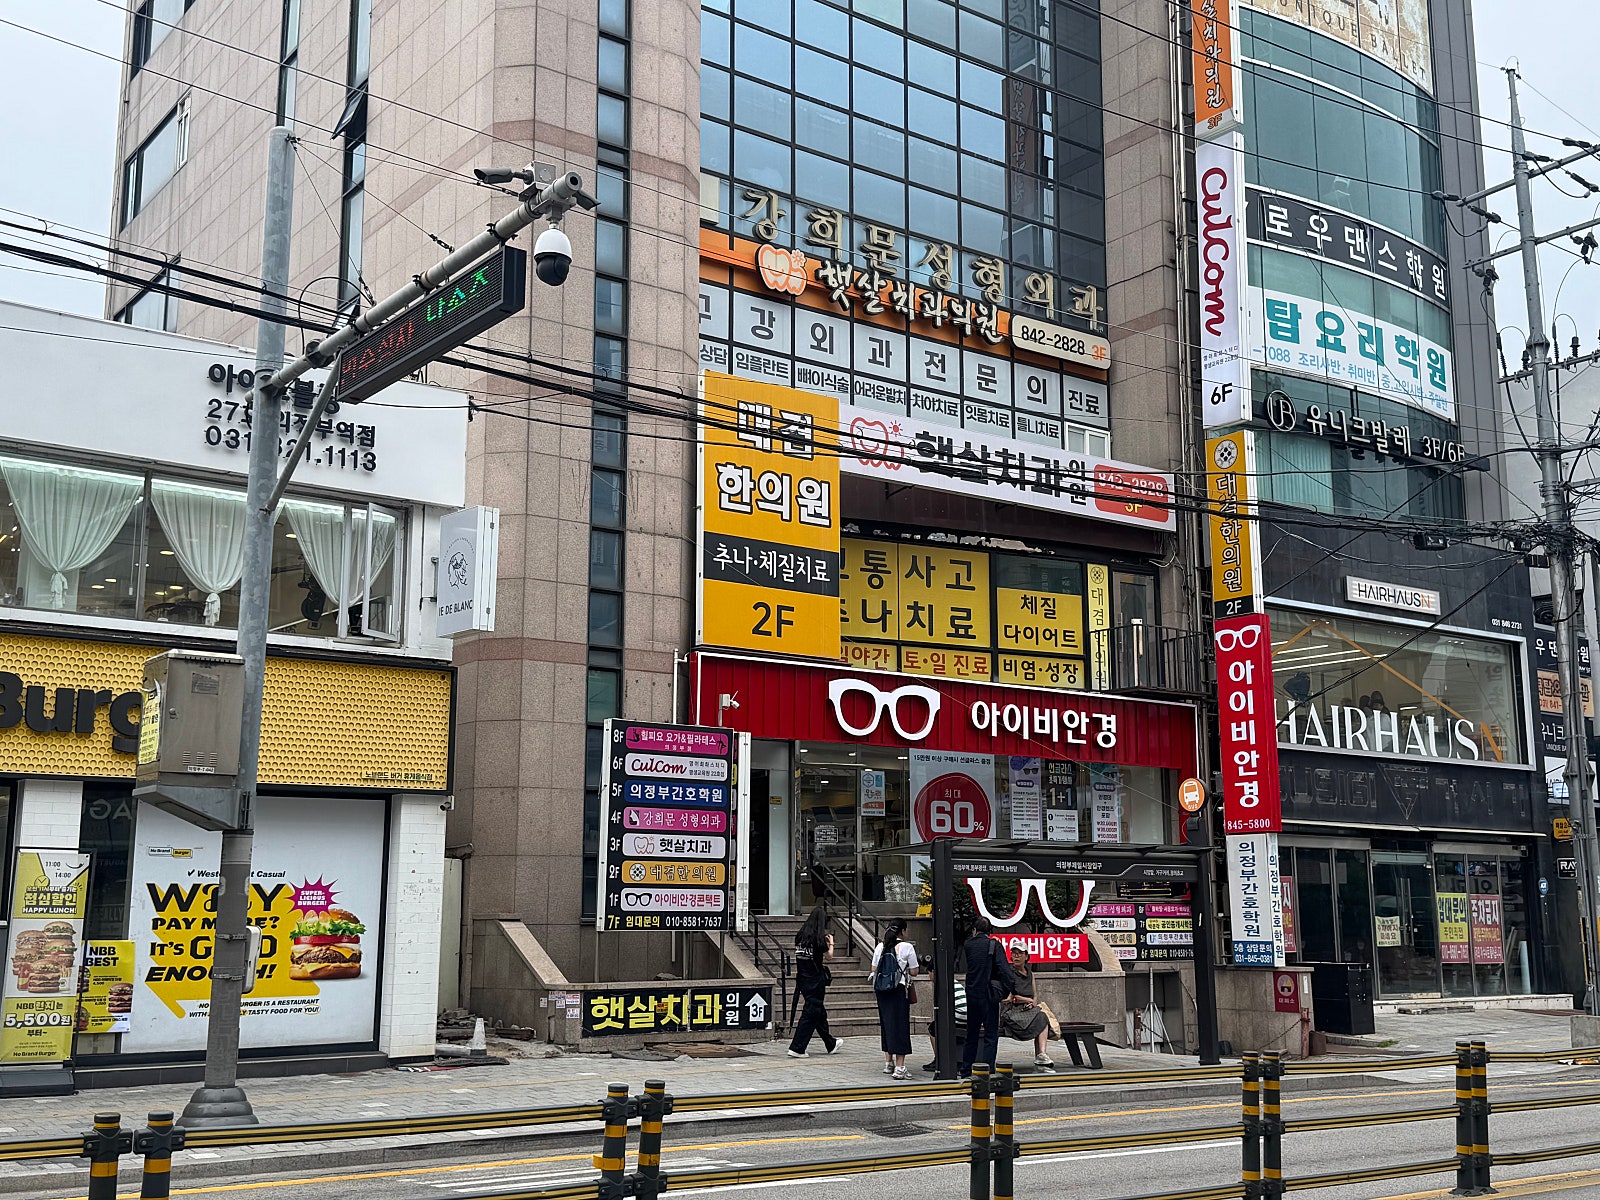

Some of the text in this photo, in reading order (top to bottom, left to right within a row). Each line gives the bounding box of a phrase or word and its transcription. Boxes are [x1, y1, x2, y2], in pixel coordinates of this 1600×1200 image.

[1207, 114, 1222, 129] 3F
[1201, 167, 1233, 337] CulCom
[816, 260, 1005, 345] 햇살치과의원
[1021, 325, 1107, 361] 842-2828 3F
[1265, 298, 1447, 392] 탑요리학원
[736, 352, 789, 379] 임플란트
[797, 368, 850, 395] 뼈이식술
[855, 380, 906, 406] 어려운발치
[912, 393, 958, 418] 치아치료
[965, 404, 1010, 428] 잇몸치료
[1017, 416, 1059, 439] 틀니치료
[1068, 389, 1100, 415] 진료
[1211, 383, 1232, 405] 6F
[1307, 405, 1412, 457] 유니크발레
[715, 462, 832, 530] 한의원
[713, 543, 831, 584] 추나·체질치료
[445, 604, 453, 615] DE
[454, 599, 473, 614] BLANC
[1021, 594, 1057, 619] 체질
[1226, 600, 1242, 615] 2F
[752, 602, 795, 638] 2F
[1004, 625, 1079, 649] 다이어트
[953, 654, 989, 676] 진료
[1003, 659, 1079, 684] 비염·성장
[0, 671, 142, 753] Burg
[970, 698, 1118, 749] 아이비안경
[613, 729, 624, 743] 8F
[1229, 660, 1260, 808] 아이비안경
[612, 758, 687, 775] 6F CulCom
[612, 783, 723, 803] 5F 의정부간호학원
[1049, 787, 1073, 807] 1+1
[611, 811, 721, 829] 4F 강희문 성형외과
[930, 800, 985, 834] 60%
[1227, 819, 1270, 830] 845-5800
[610, 837, 712, 854] 3F 햇살치과
[256, 870, 286, 878] Casual
[609, 865, 620, 879] 2F
[24, 892, 77, 906] 점심할인
[609, 893, 721, 907] 1F 아이비안경콘택트
[1238, 841, 1260, 938] 의정부간호학원
[1269, 855, 1284, 959] 의정부간호학원
[1438, 897, 1467, 923] 임대문의
[1471, 900, 1499, 925] 주차금지
[152, 916, 280, 930] PAY MRE?
[608, 915, 722, 929] 7F 임대문의 010-8581-7637
[88, 946, 116, 956] NBB
[150, 935, 278, 960] IT'S GD
[1247, 943, 1273, 953] 상담문의
[85, 957, 119, 967] BEST
[5, 1012, 72, 1029] 5,500원
[590, 993, 723, 1031] 햇살치과
[751, 1002, 764, 1018] 3F
